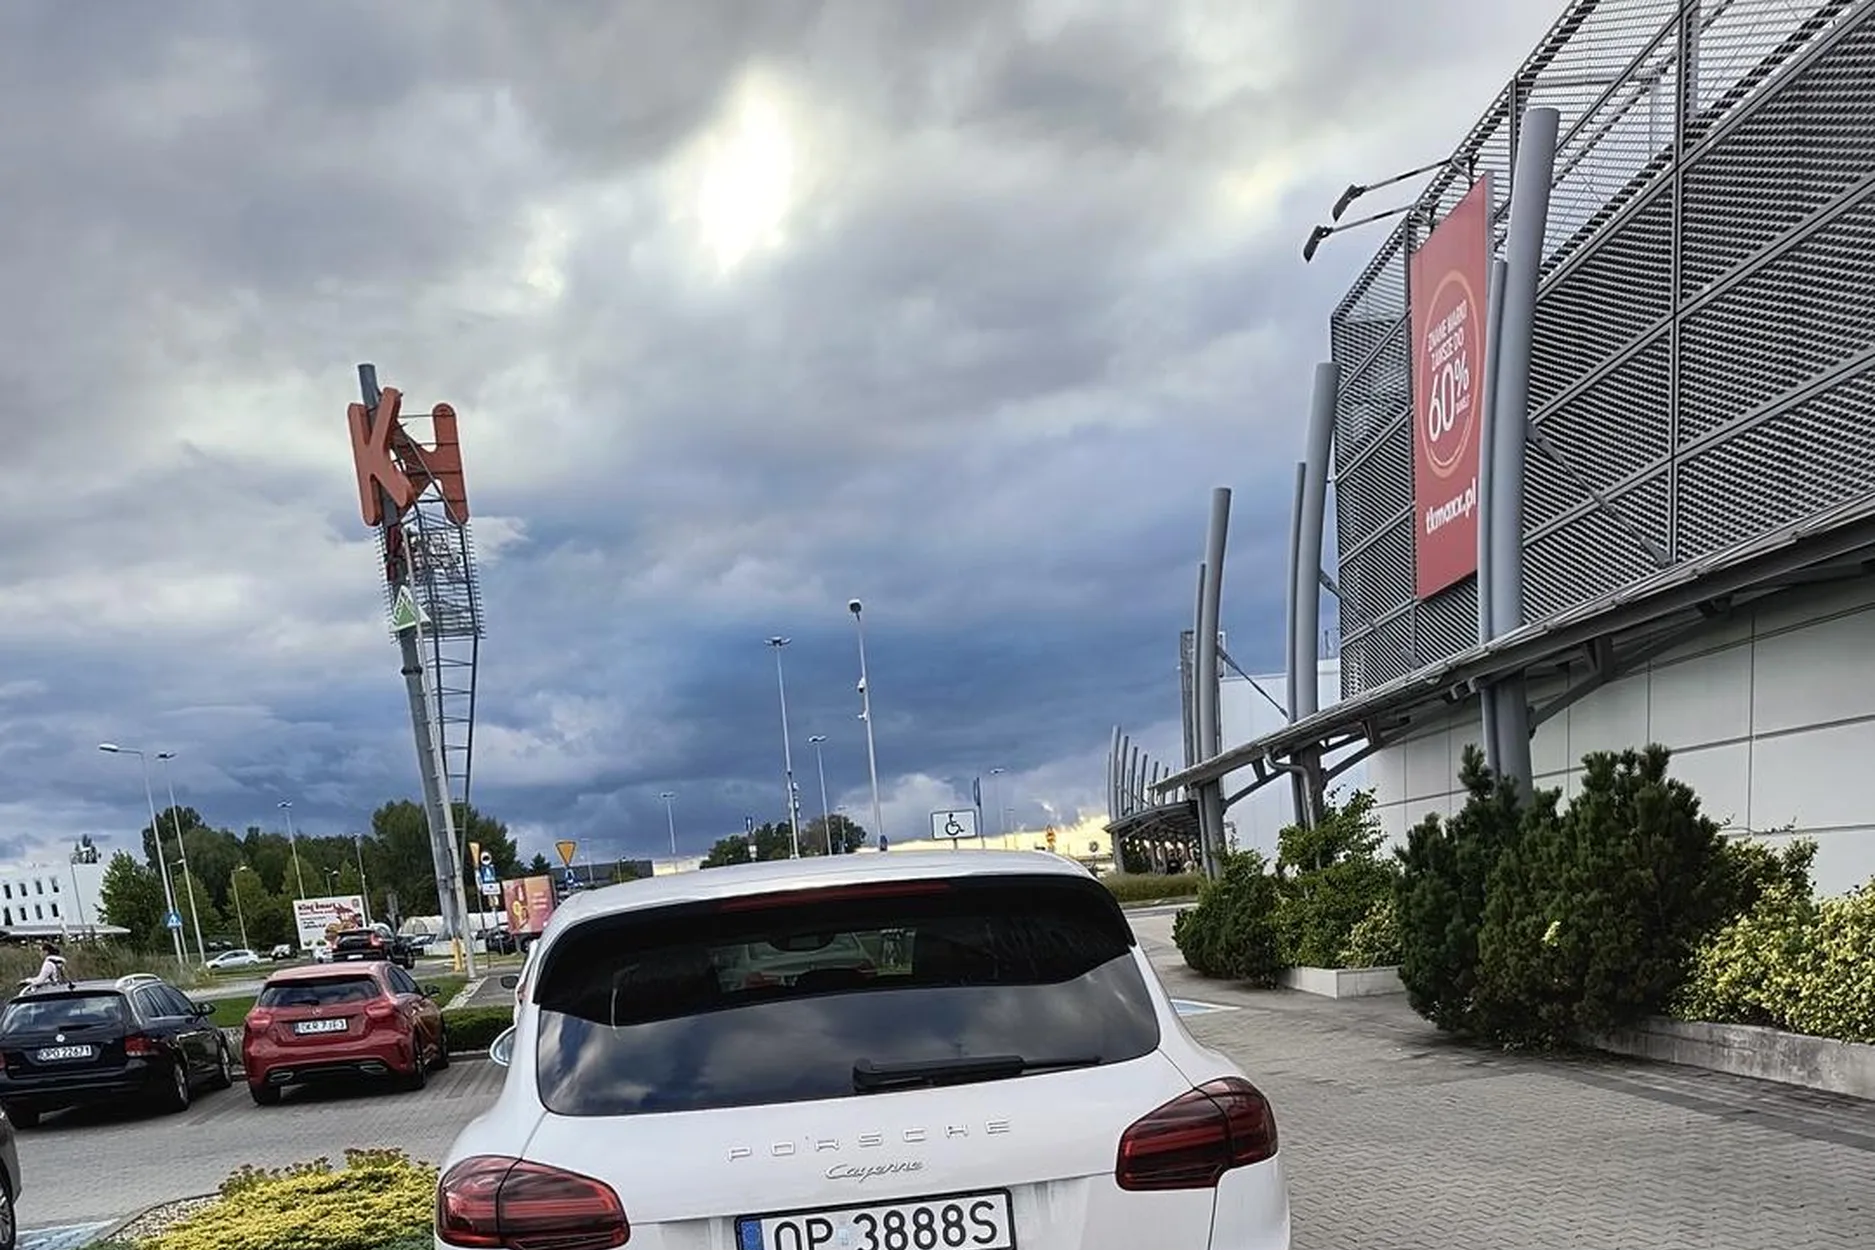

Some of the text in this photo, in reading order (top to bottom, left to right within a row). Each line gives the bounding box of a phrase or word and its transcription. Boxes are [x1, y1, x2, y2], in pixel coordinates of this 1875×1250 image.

[1428, 349, 1470, 443] 60%
[1425, 477, 1477, 535] tkmaxx.pl
[728, 1119, 1011, 1162] PORSCHE
[825, 1159, 924, 1183] Cayenne
